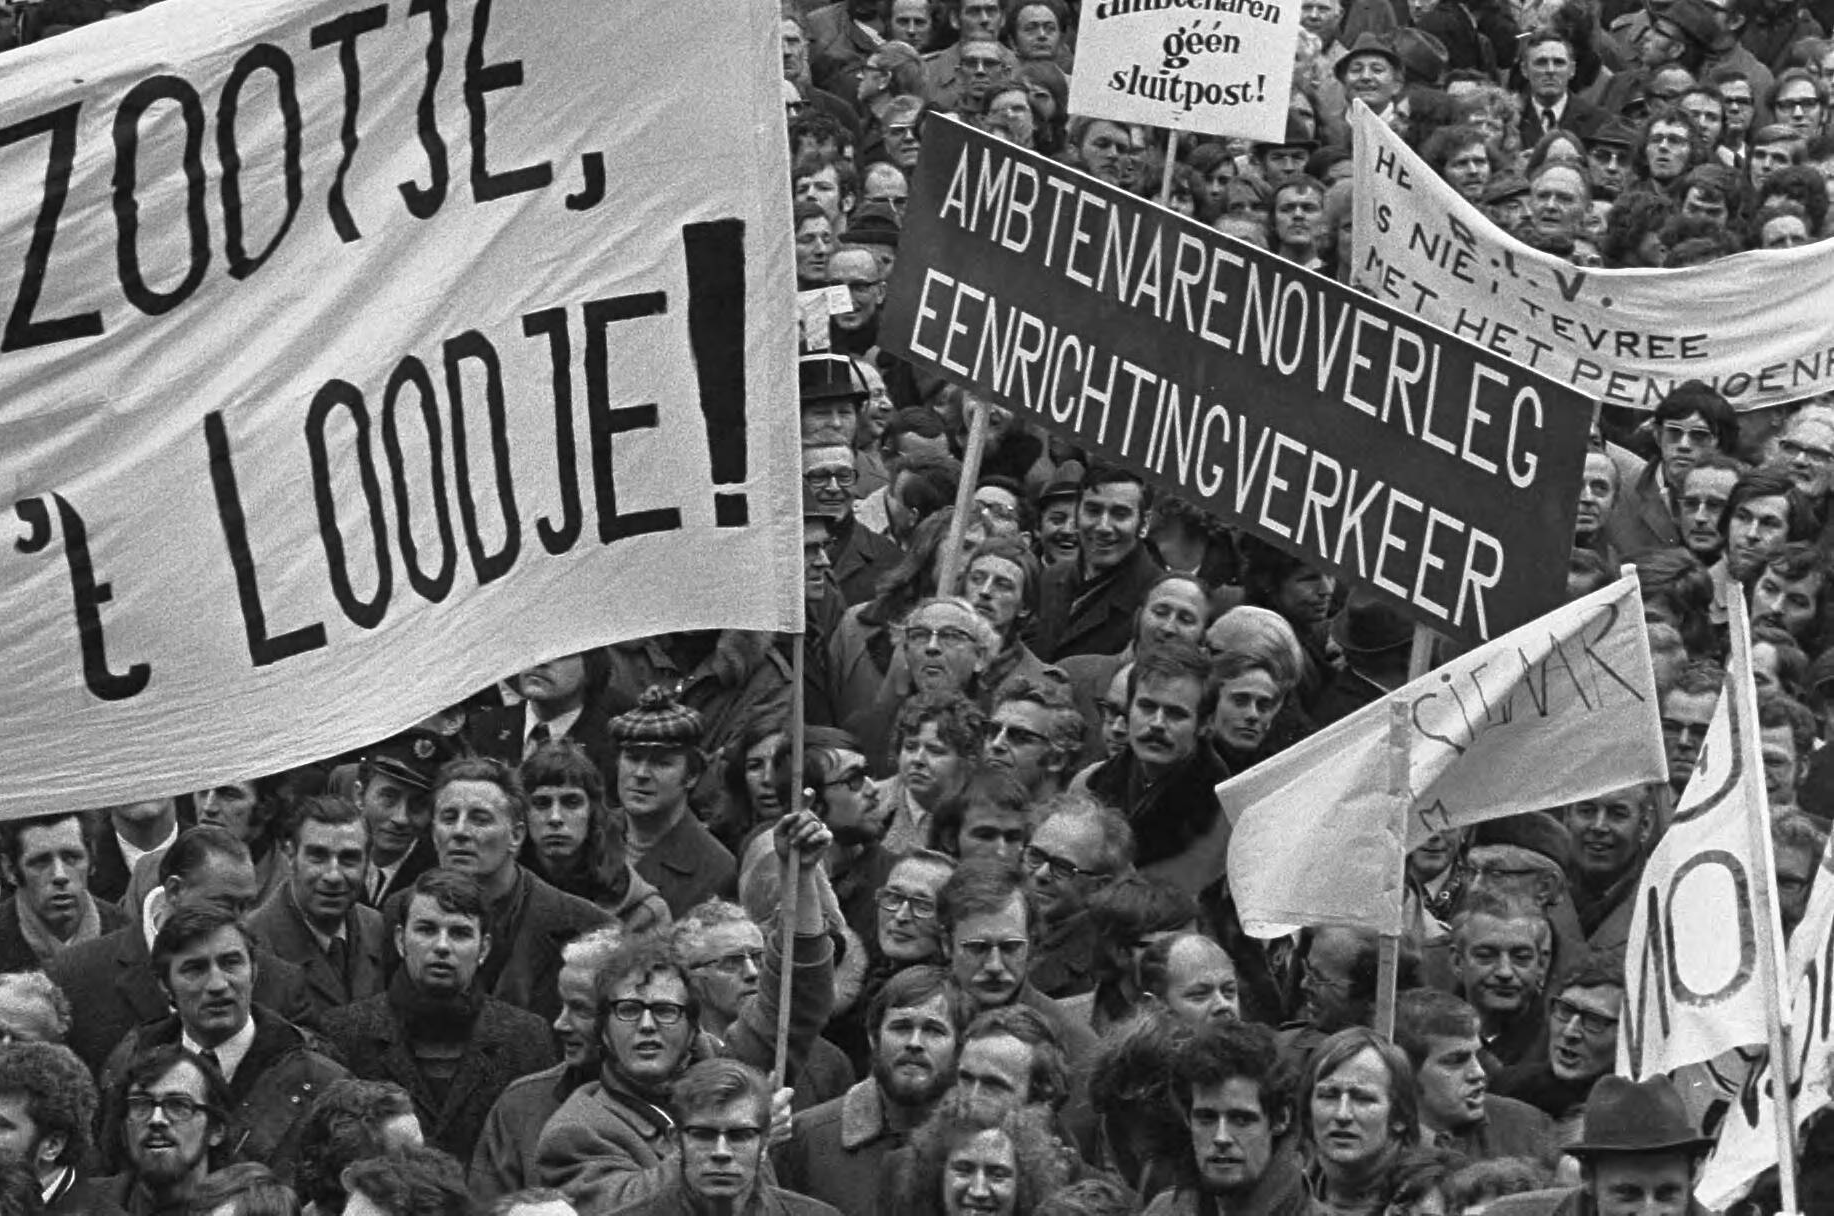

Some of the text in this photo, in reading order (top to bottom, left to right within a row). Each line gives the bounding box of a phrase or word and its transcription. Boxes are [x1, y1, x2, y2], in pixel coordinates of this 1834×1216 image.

[1107, 64, 1267, 112] sluitpost!
[1162, 19, 1241, 69] géén
[1366, 245, 1439, 314] MET
[1454, 307, 1554, 369] HET
[204, 217, 750, 668] LOODJE!
[908, 267, 1506, 642] EENRICHTINGVERKEER
